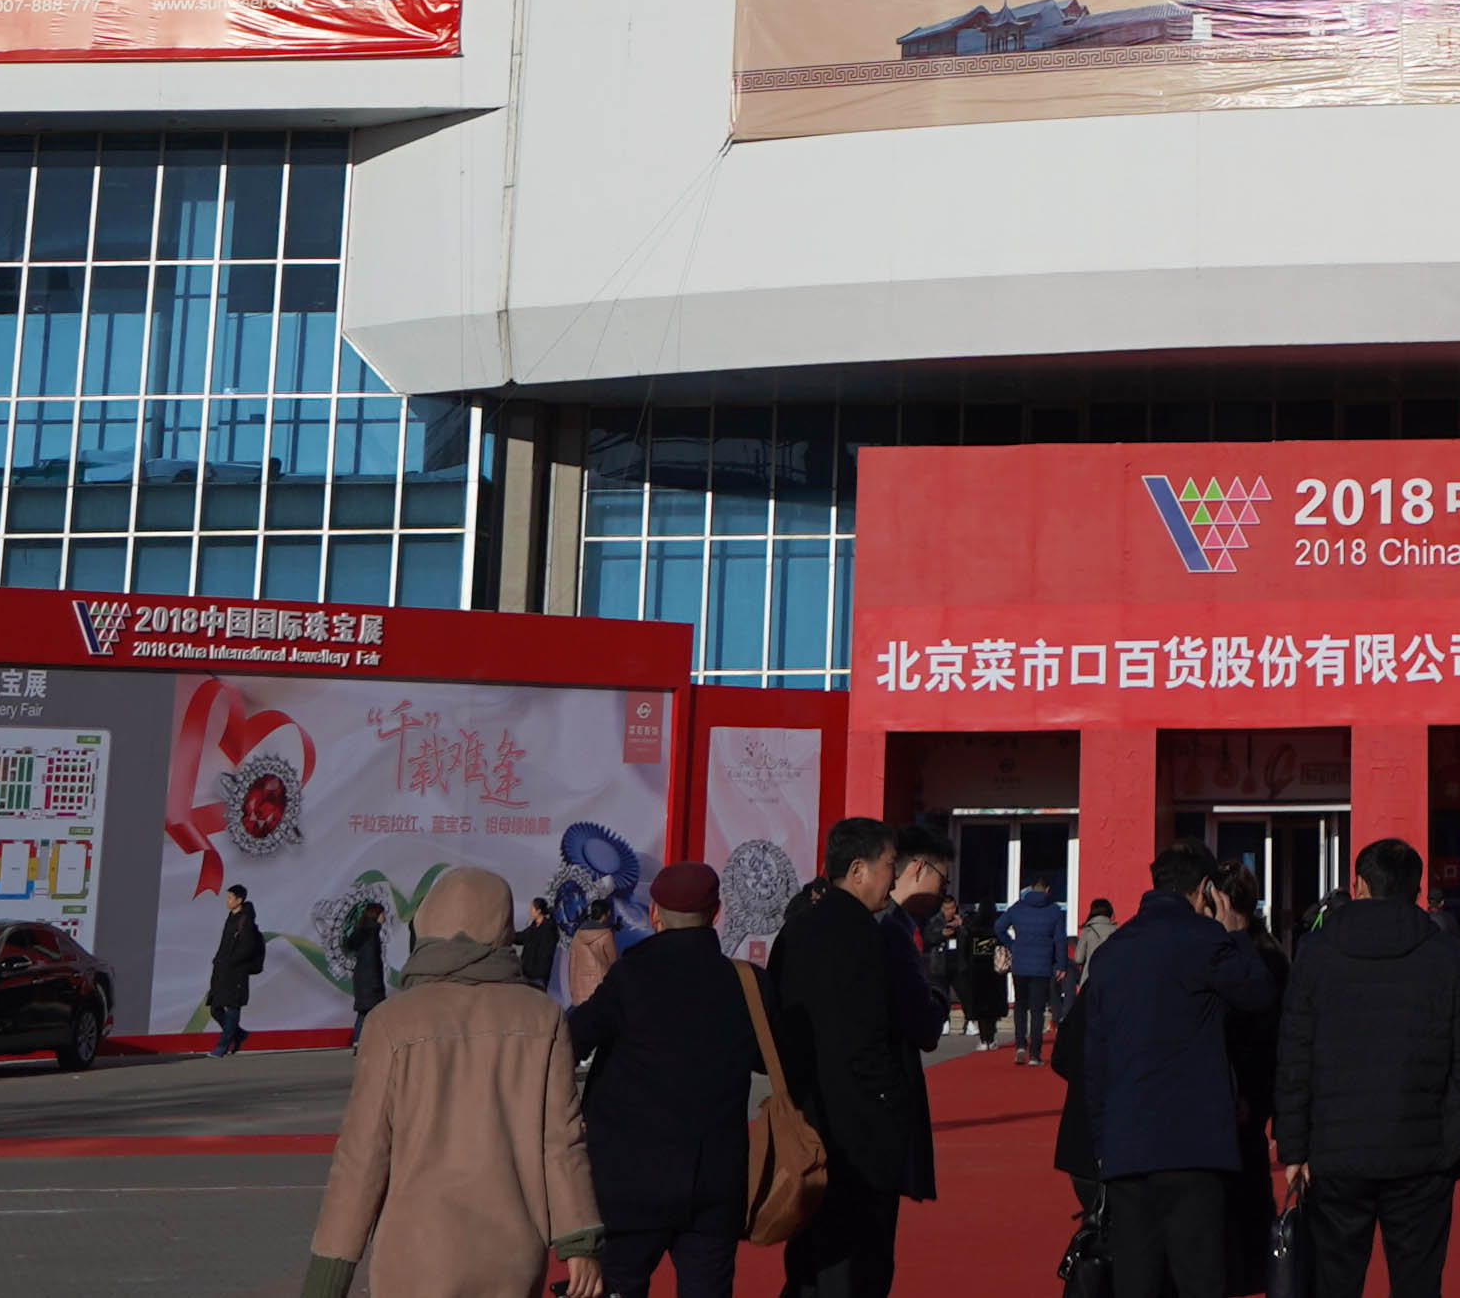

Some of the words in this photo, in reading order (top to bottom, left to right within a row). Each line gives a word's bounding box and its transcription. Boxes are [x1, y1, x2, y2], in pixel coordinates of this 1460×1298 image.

[1294, 538, 1367, 568] 2018
[132, 640, 167, 659] 2018
[169, 643, 207, 661] China
[209, 644, 286, 663] International
[288, 648, 350, 668] Jewellery
[356, 651, 382, 668] Fair
[21, 702, 44, 717] Fair
